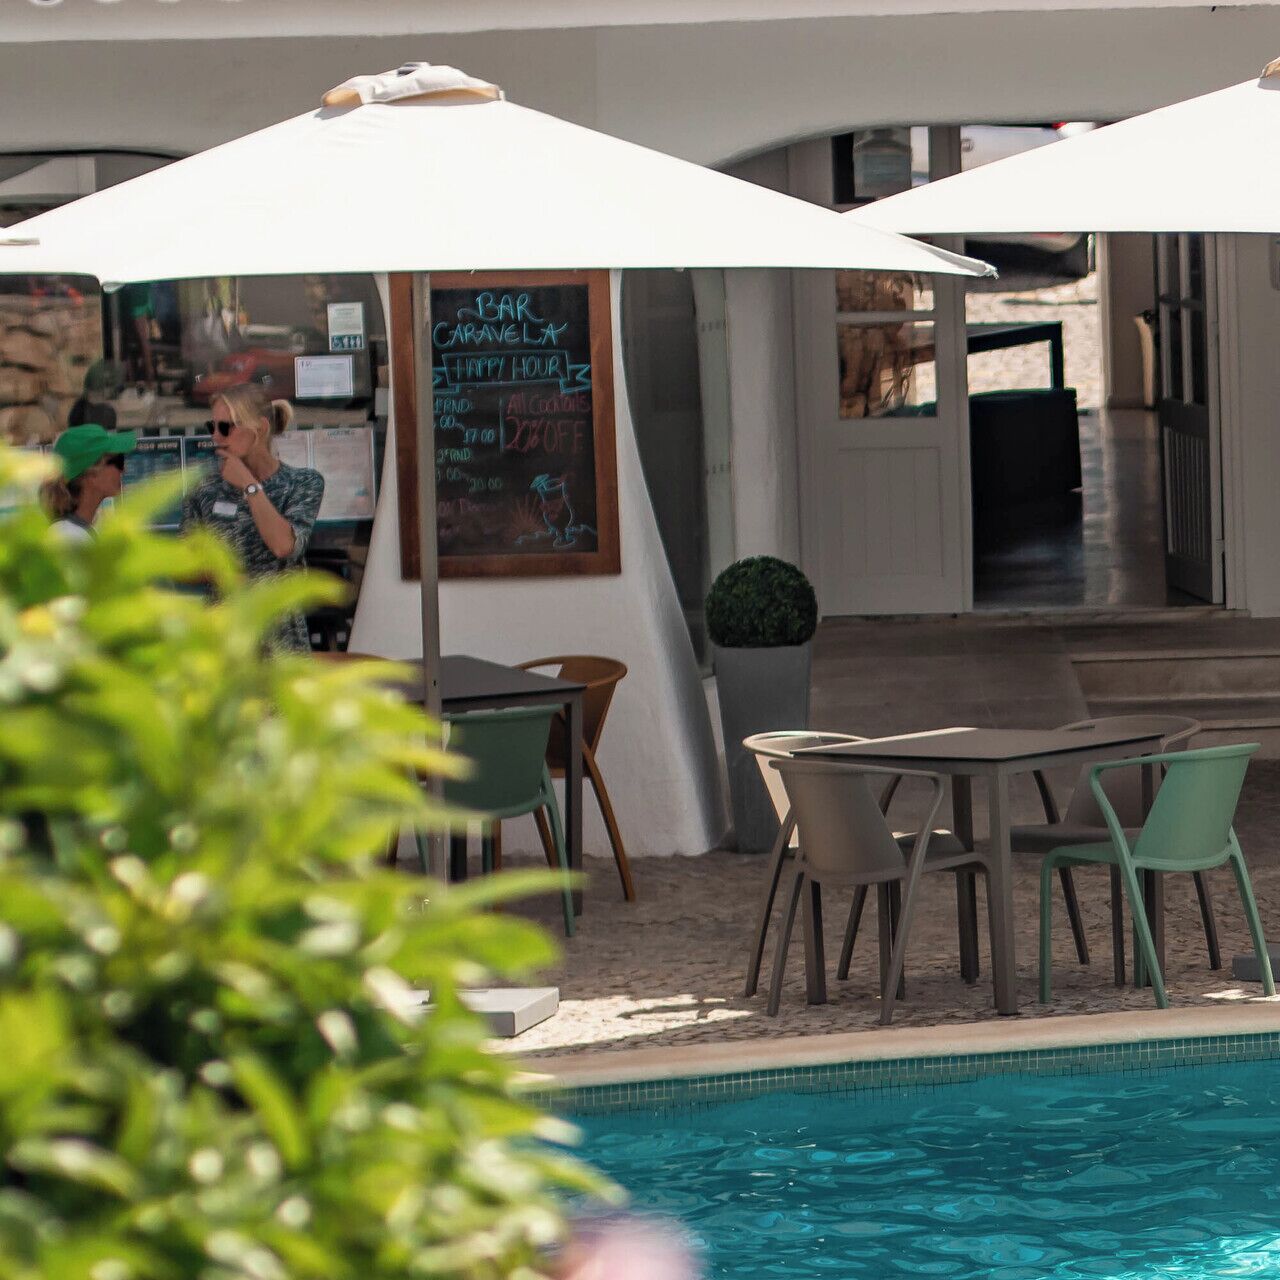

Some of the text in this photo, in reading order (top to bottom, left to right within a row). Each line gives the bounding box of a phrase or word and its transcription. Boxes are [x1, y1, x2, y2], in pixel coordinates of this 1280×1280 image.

[458, 291, 544, 323] BAR
[433, 321, 568, 349] CARAVELA
[455, 355, 563, 380] HAPPY HOUR
[543, 419, 587, 453] OFF
